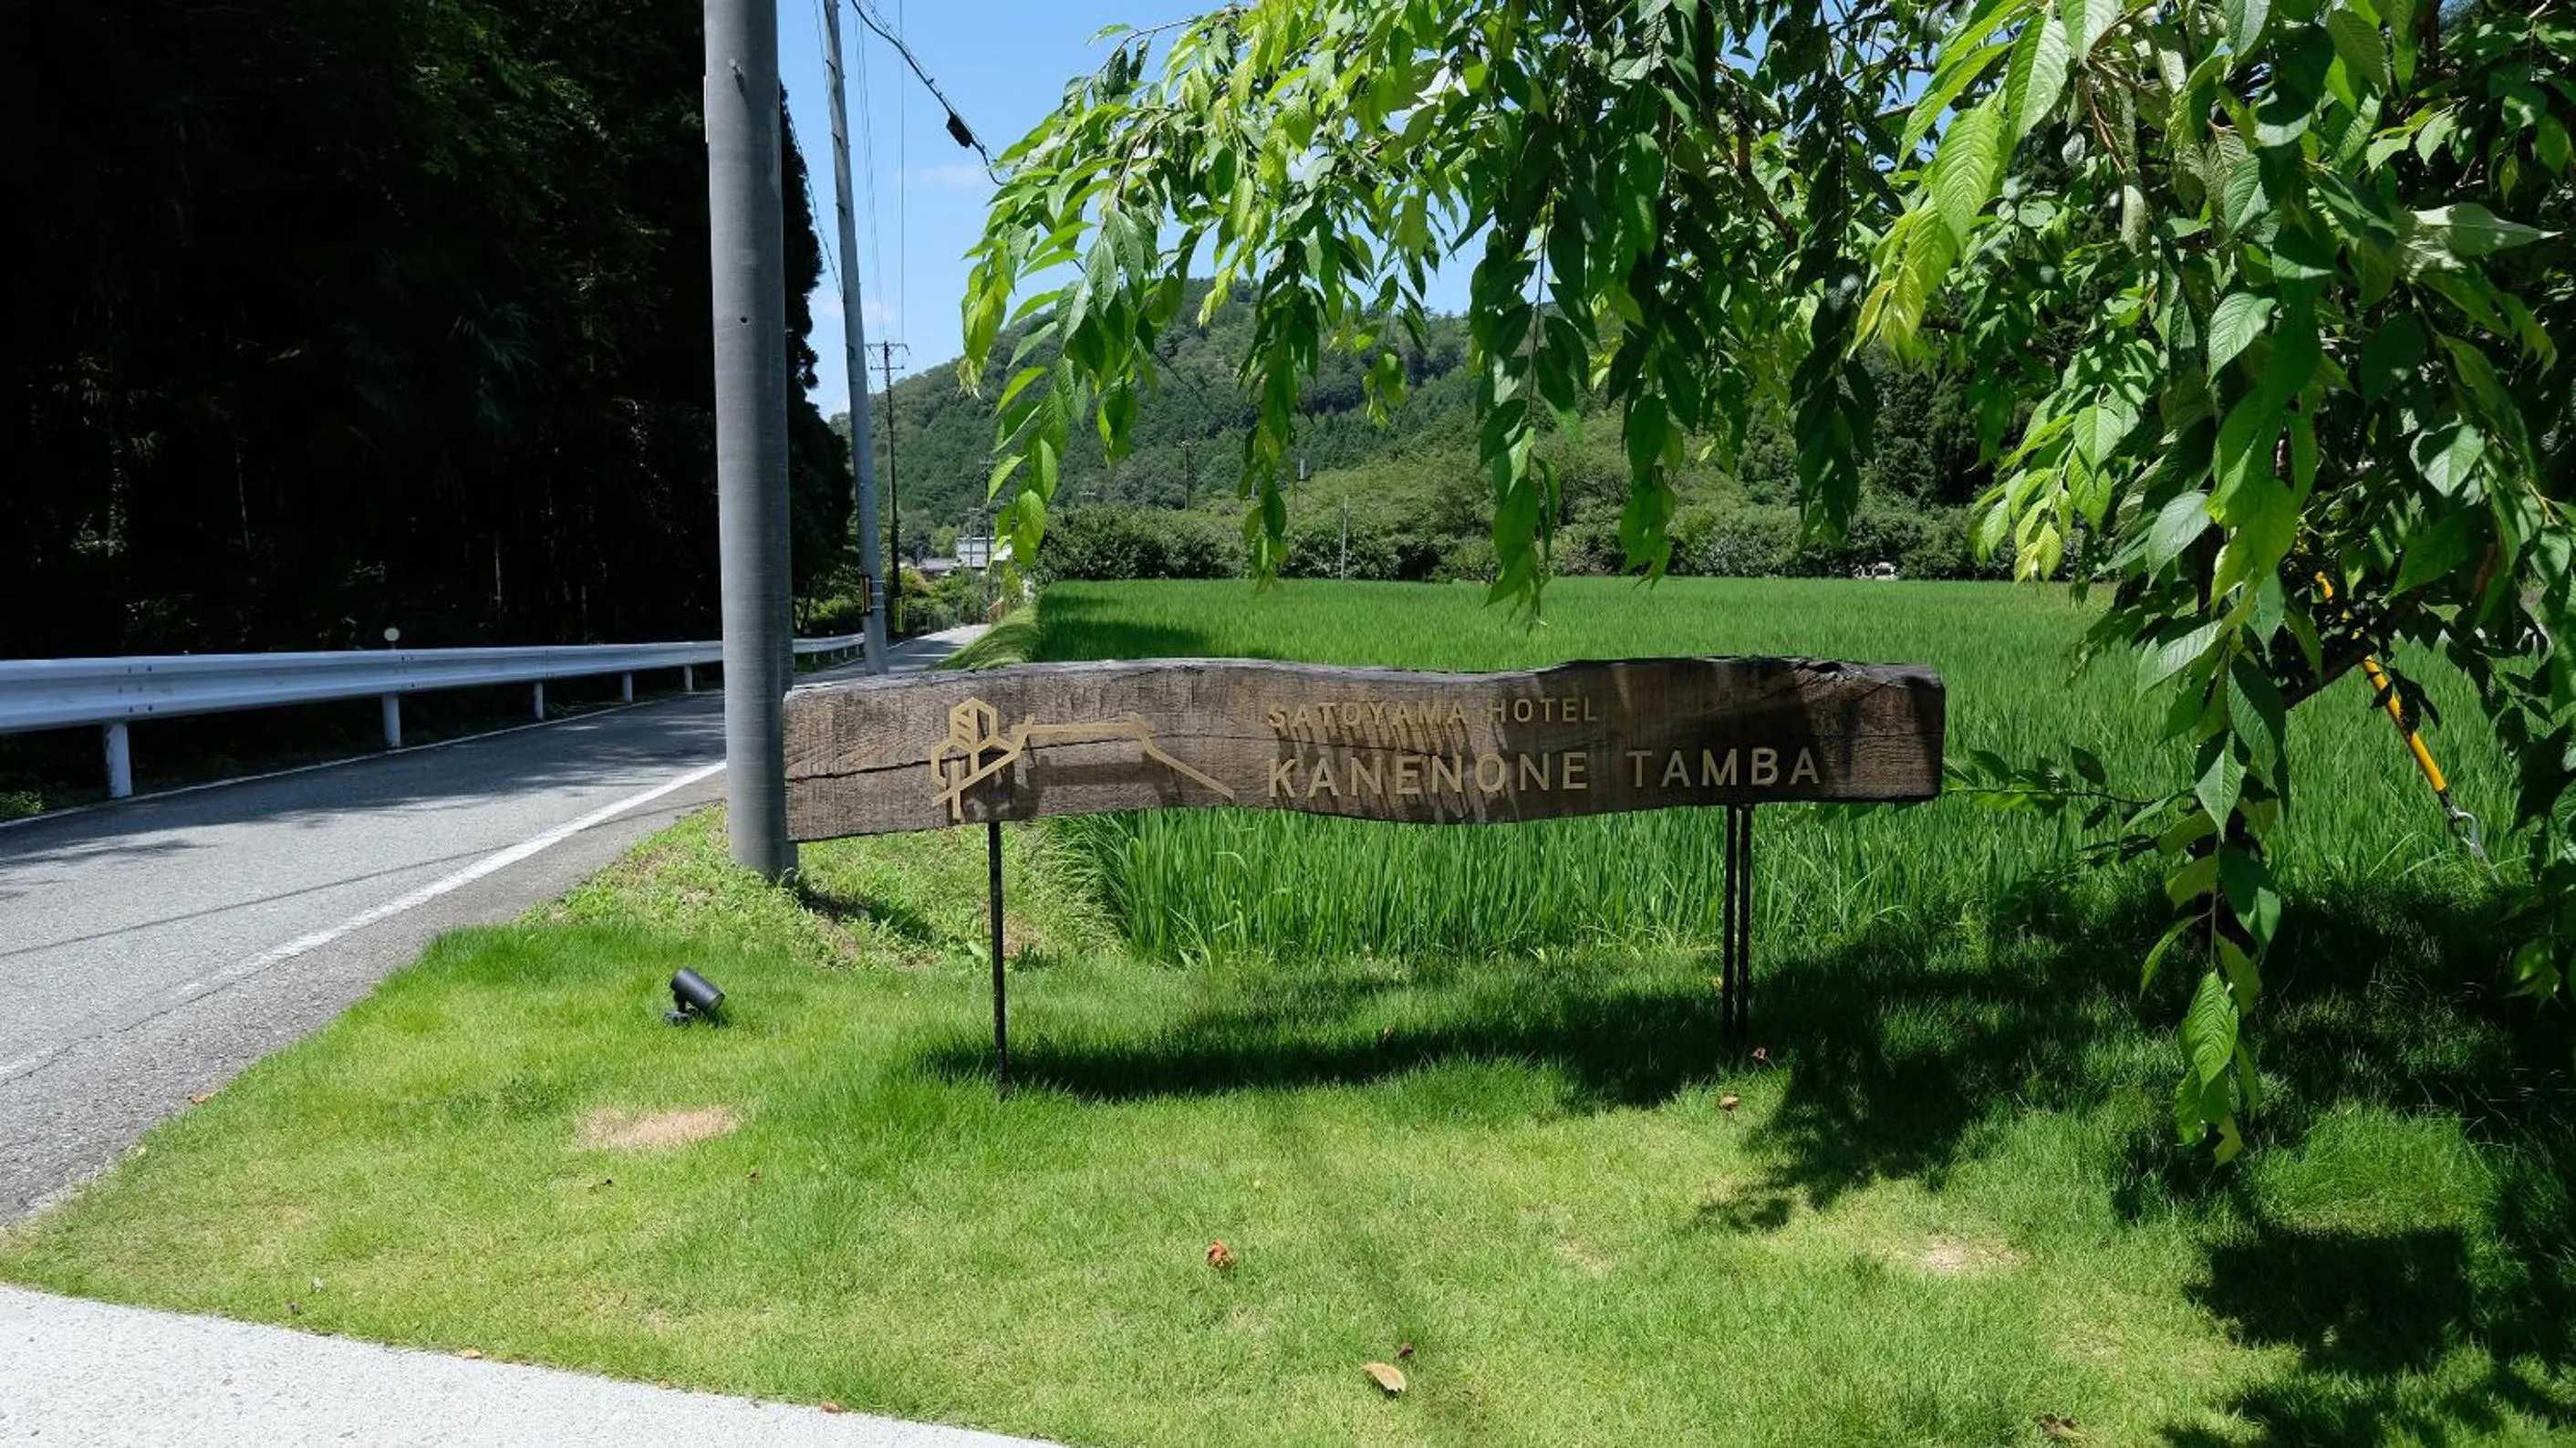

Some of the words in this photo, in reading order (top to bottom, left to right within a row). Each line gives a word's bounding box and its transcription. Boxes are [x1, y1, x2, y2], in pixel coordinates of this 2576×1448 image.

[1267, 700, 1468, 728] SATOYAMA
[1487, 697, 1599, 723] HOTEL
[1267, 752, 1589, 797] KANENONE
[1626, 746, 1820, 788] TAMBA
